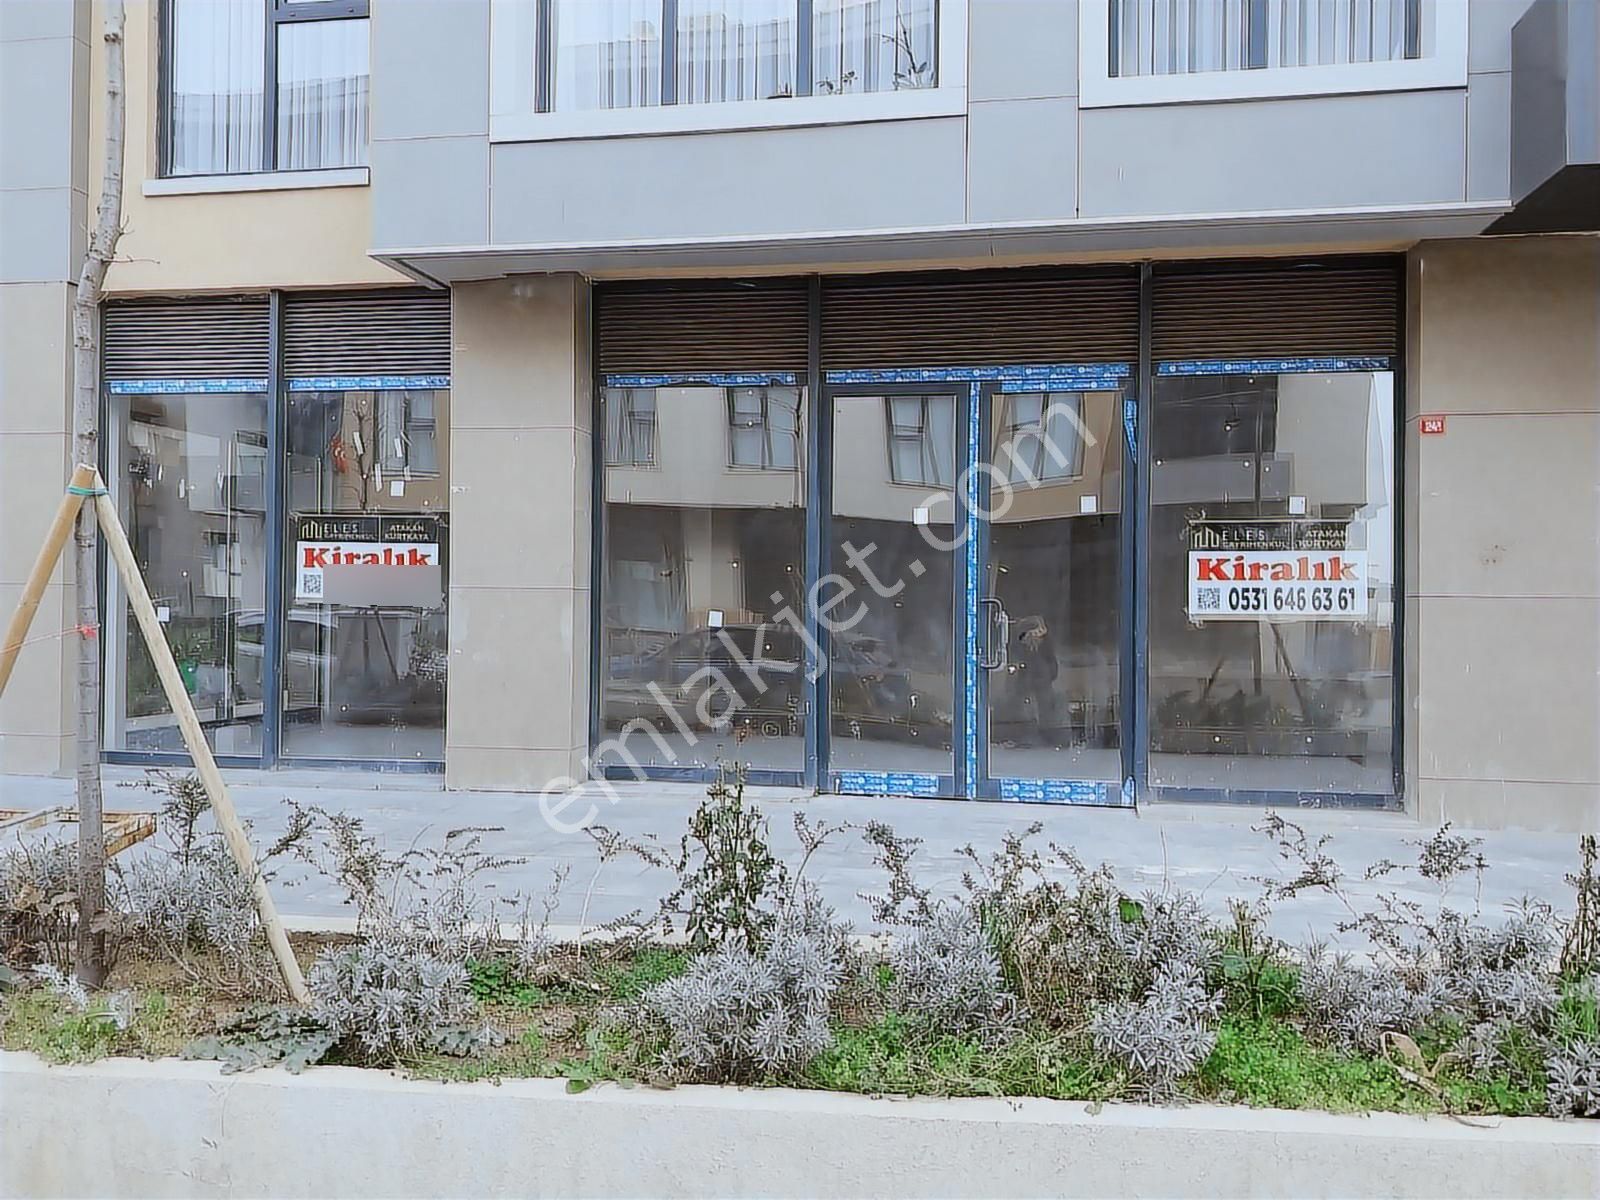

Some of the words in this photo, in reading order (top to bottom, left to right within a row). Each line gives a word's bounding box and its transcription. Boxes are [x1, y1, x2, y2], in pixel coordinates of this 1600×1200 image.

[303, 546, 431, 568] Kiralık
[1196, 555, 1360, 582] Kiralık
[1228, 587, 1268, 611] 0531
[1273, 587, 1306, 611] 646
[1312, 587, 1333, 611] 63
[1338, 587, 1355, 611] 61
